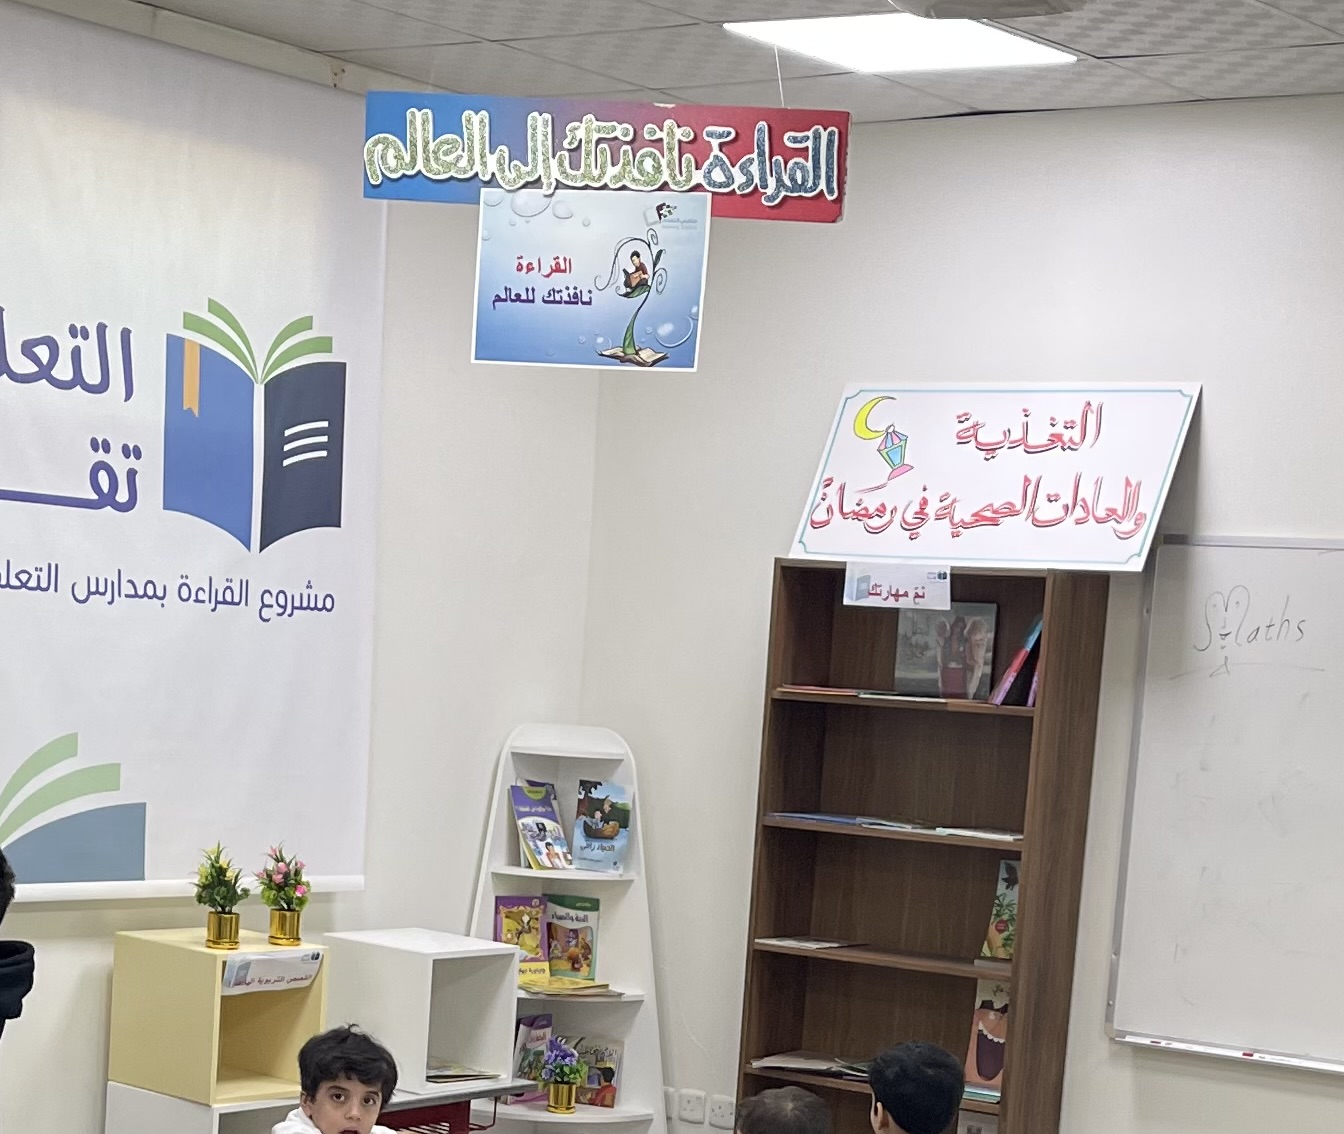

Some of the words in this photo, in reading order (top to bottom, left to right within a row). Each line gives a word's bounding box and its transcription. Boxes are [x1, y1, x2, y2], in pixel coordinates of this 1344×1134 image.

[364, 108, 491, 184] العالم
[556, 114, 694, 189] نافذتك
[702, 121, 839, 206] القراءة
[516, 256, 573, 281] القراءة
[491, 286, 536, 311] للعالم
[541, 286, 593, 308] نافذتك
[956, 400, 1103, 461] التغذية
[900, 484, 930, 541] في
[934, 473, 1042, 539] الصحية
[71, 568, 167, 609] بمدارس
[178, 574, 250, 612] القراءة
[258, 580, 335, 623] مشروع
[867, 582, 909, 603] مهارتك
[1193, 585, 1306, 652] Maths
